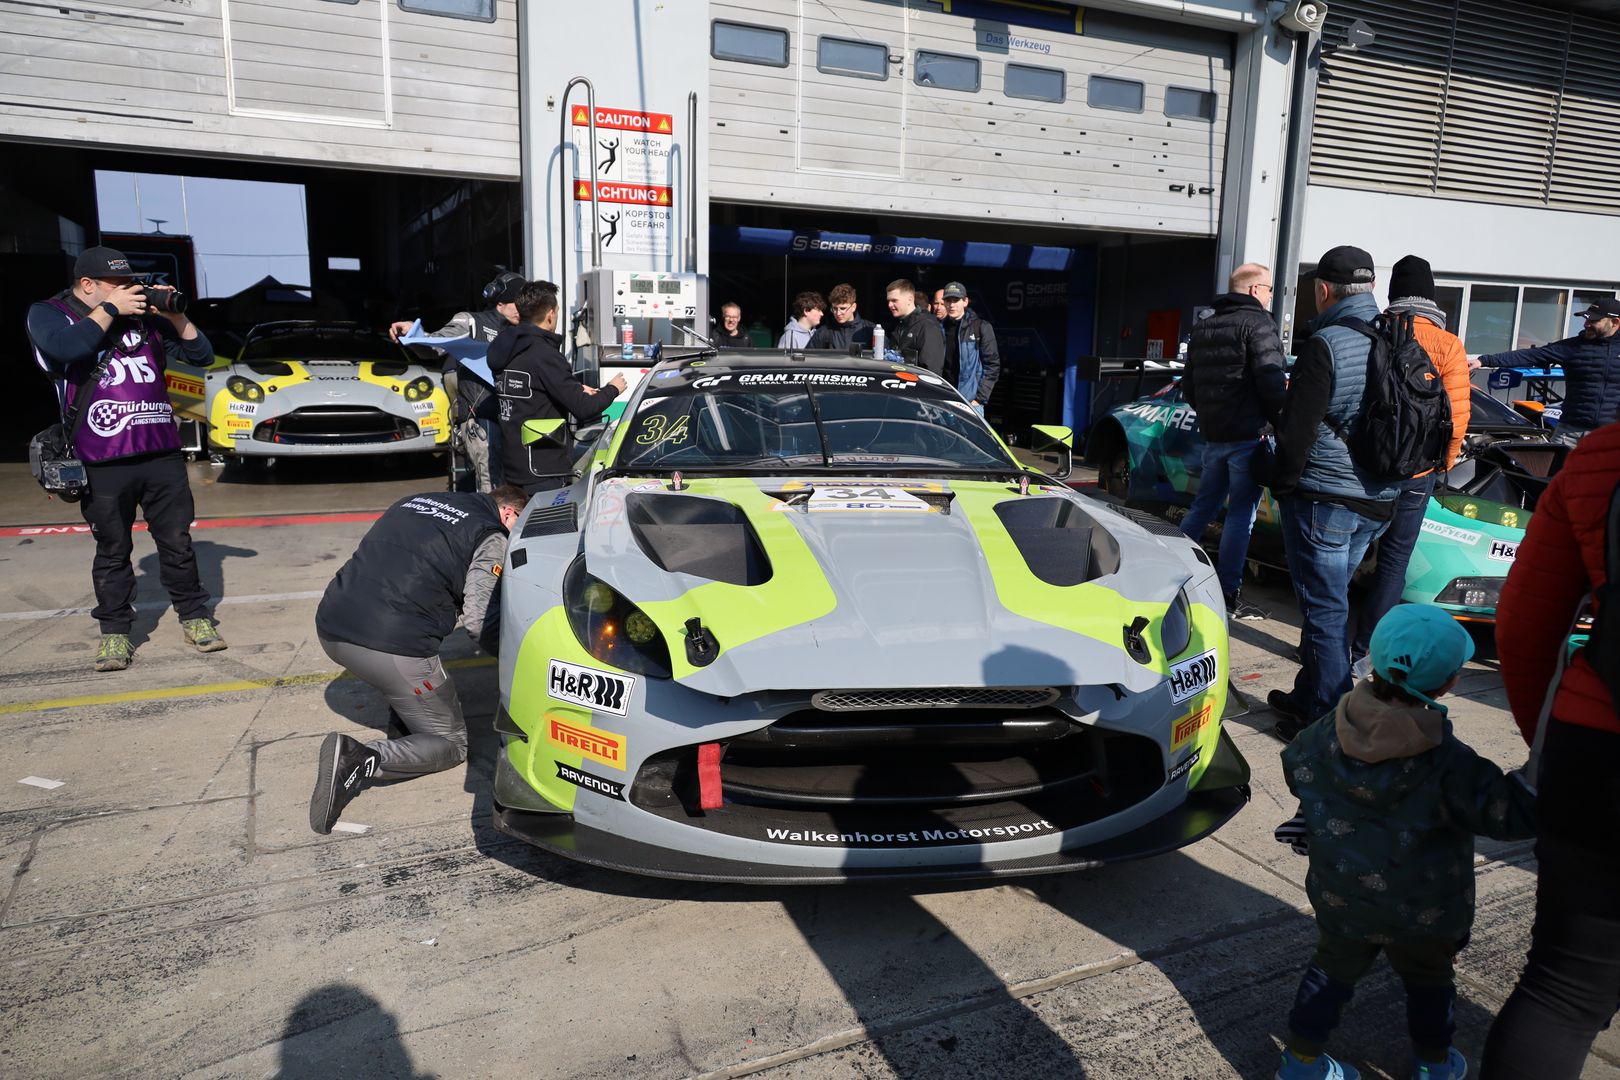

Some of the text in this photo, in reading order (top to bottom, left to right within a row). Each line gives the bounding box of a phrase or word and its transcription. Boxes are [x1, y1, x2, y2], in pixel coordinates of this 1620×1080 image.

[985, 33, 1051, 54] Das Werkzeug
[595, 112, 650, 128] CAUTION
[624, 147, 670, 158] YOUR HEAD
[633, 138, 661, 148] WATCH
[630, 219, 665, 229] GEFAHR
[810, 239, 872, 253] SCHERER
[874, 244, 913, 255] SPORT
[913, 246, 936, 257] PHX
[1026, 283, 1068, 295] SCHERE
[615, 306, 625, 315] 23
[685, 307, 696, 316] 22
[166, 374, 205, 396] PIREL
[739, 374, 868, 384] GRAN TURISMO
[1122, 404, 1201, 433] UMARE
[636, 414, 691, 445] 34
[823, 488, 895, 500] 34
[411, 497, 469, 519] Walkenhorst
[1421, 520, 1476, 543] OODYEAR
[1491, 542, 1515, 558] H&
[551, 665, 593, 699] H&R
[1170, 662, 1203, 695] H&R
[1174, 704, 1212, 745] PIRELLI
[550, 719, 619, 761] PIRELLI
[560, 766, 620, 796] RAVENOL
[766, 819, 1054, 843] Walkenhorst Motorsport
